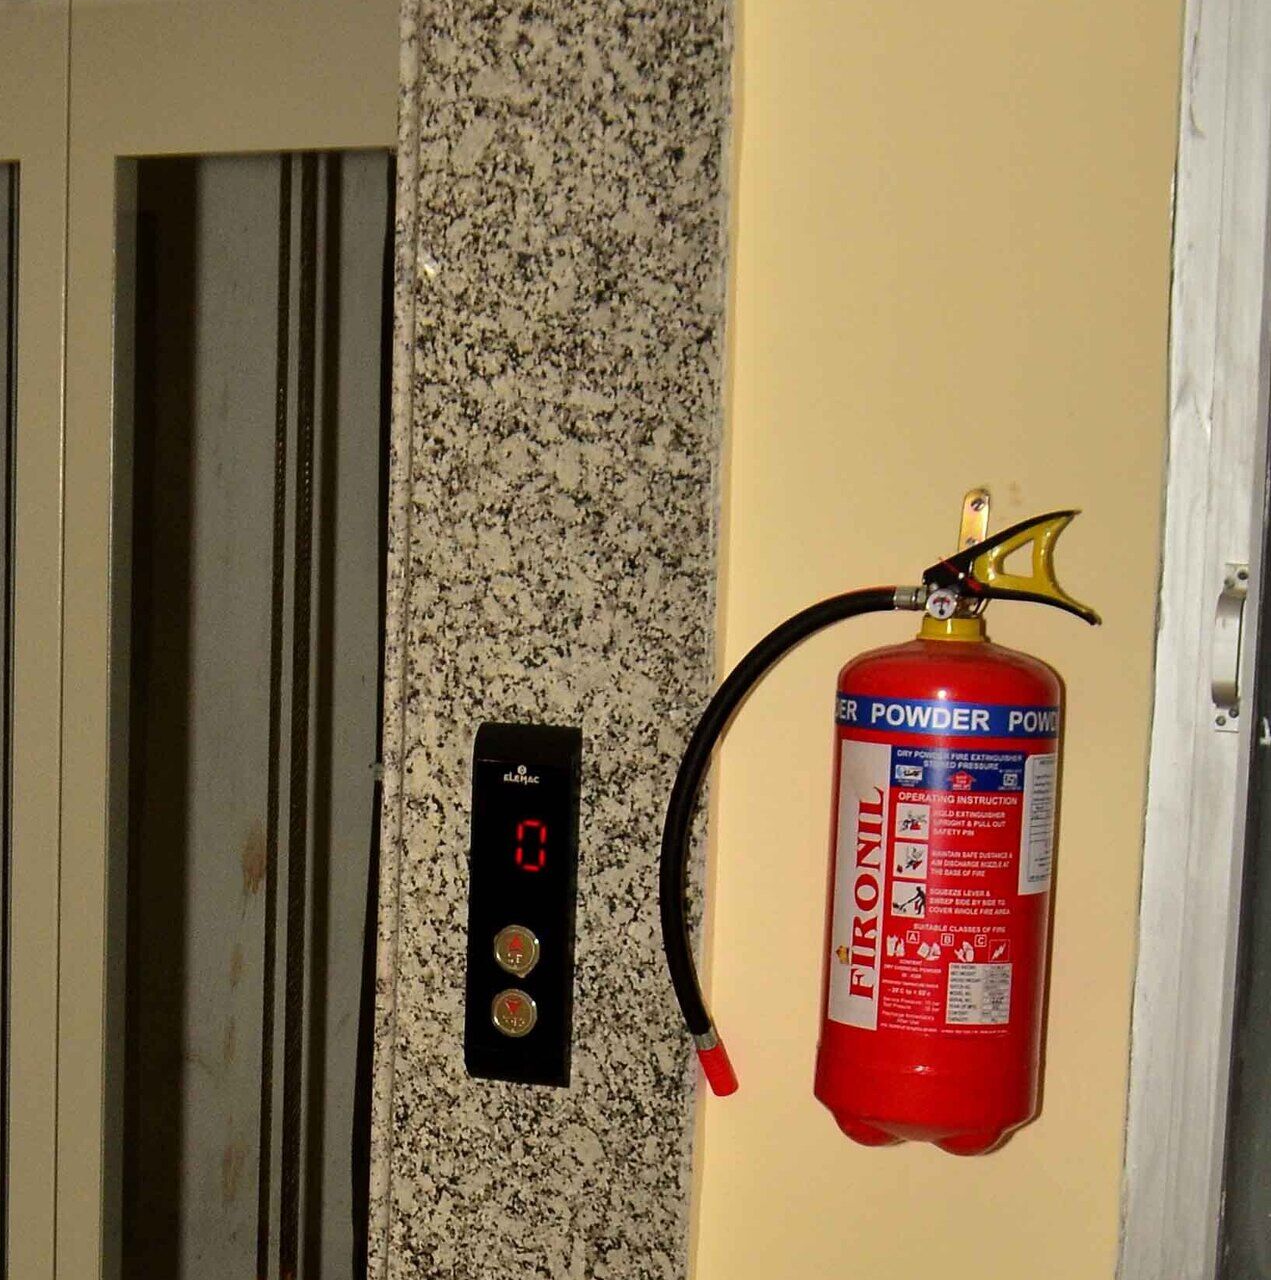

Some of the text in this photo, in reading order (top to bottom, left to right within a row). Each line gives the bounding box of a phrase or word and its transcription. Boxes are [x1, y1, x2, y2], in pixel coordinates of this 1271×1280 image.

[871, 702, 990, 731] POWDER
[950, 753, 969, 761] FIRE
[958, 761, 999, 770] PRESSURE
[898, 792, 1017, 805] OPERATING INSTRUCTION
[515, 820, 547, 871] 0
[849, 787, 884, 999] FIRONIL
[949, 925, 981, 933] CLASSES
[909, 933, 917, 941] A
[944, 936, 951, 944] B
[978, 937, 984, 945] C
